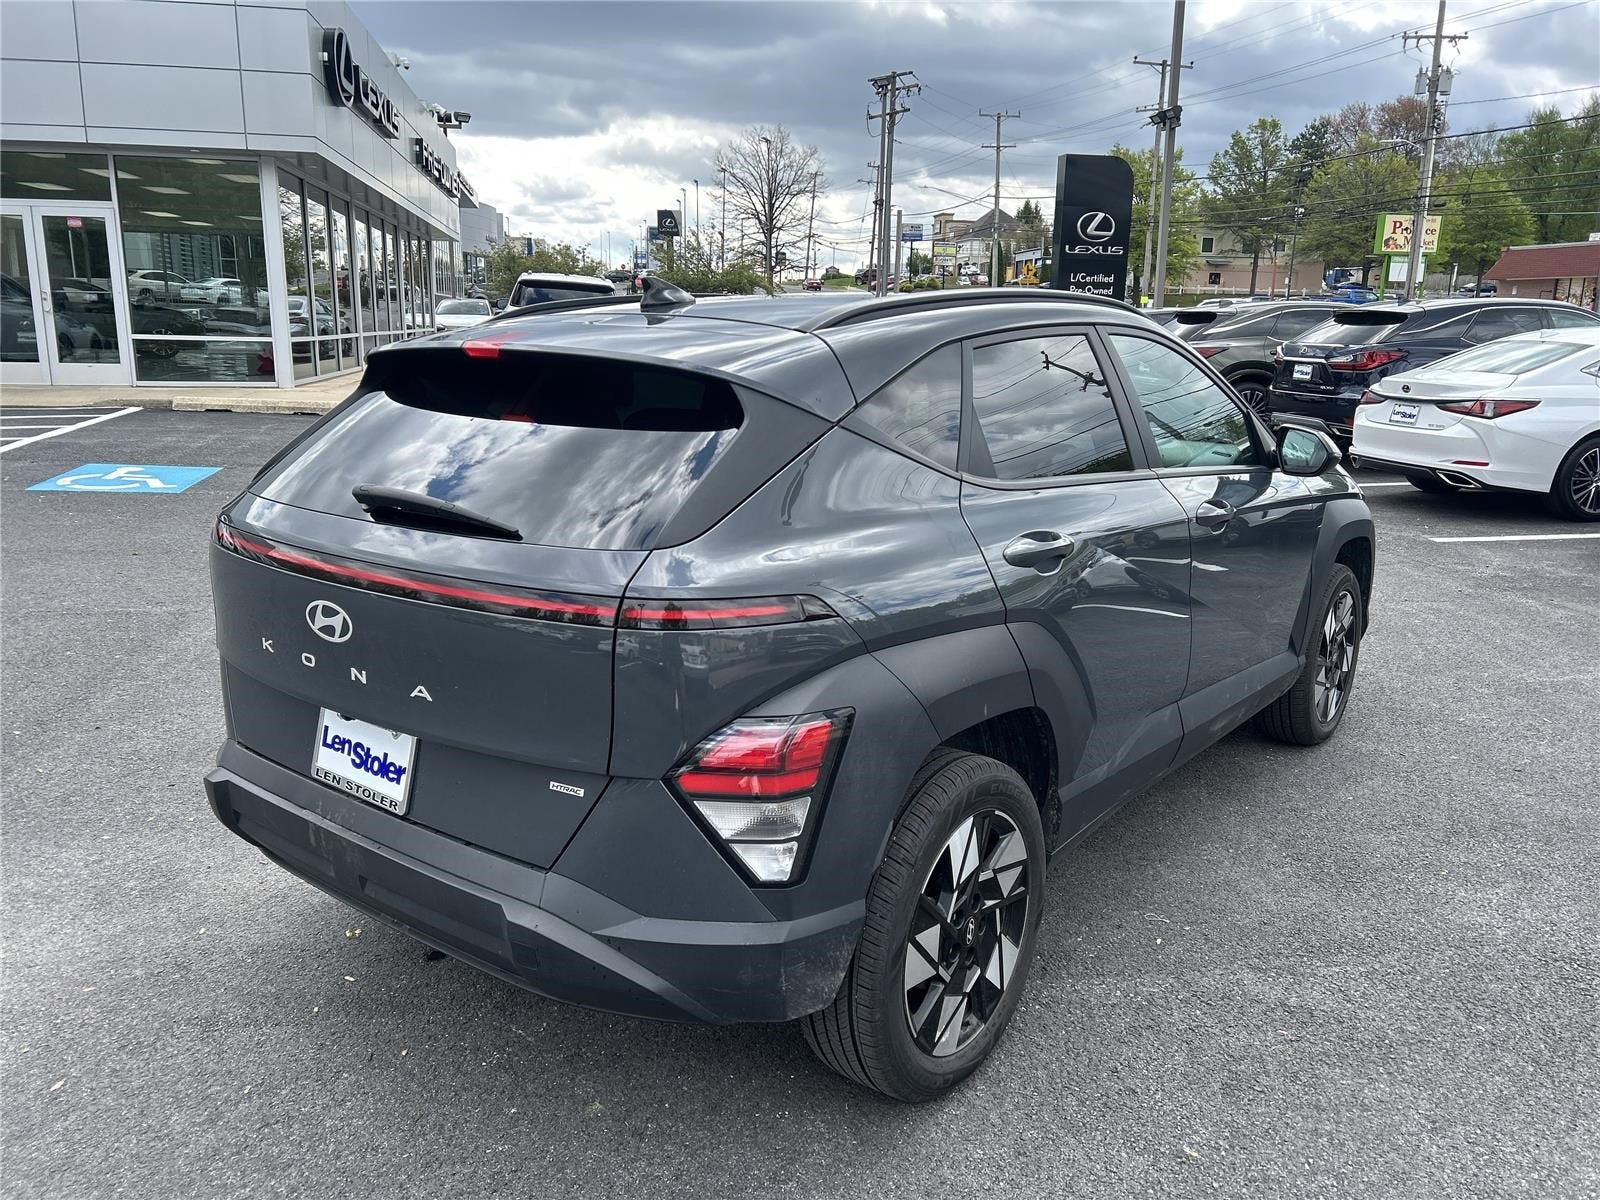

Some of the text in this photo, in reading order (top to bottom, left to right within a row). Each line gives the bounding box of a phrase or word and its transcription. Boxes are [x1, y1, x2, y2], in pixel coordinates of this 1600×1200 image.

[354, 65, 399, 139] LEXUS
[1065, 244, 1124, 255] LEXUS
[1070, 273, 1114, 283] L/Certified
[1070, 286, 1113, 295] Pre-Owned
[261, 637, 433, 702] KONA
[315, 768, 398, 811] LEN STOLER
[551, 783, 582, 796] HTRAC
